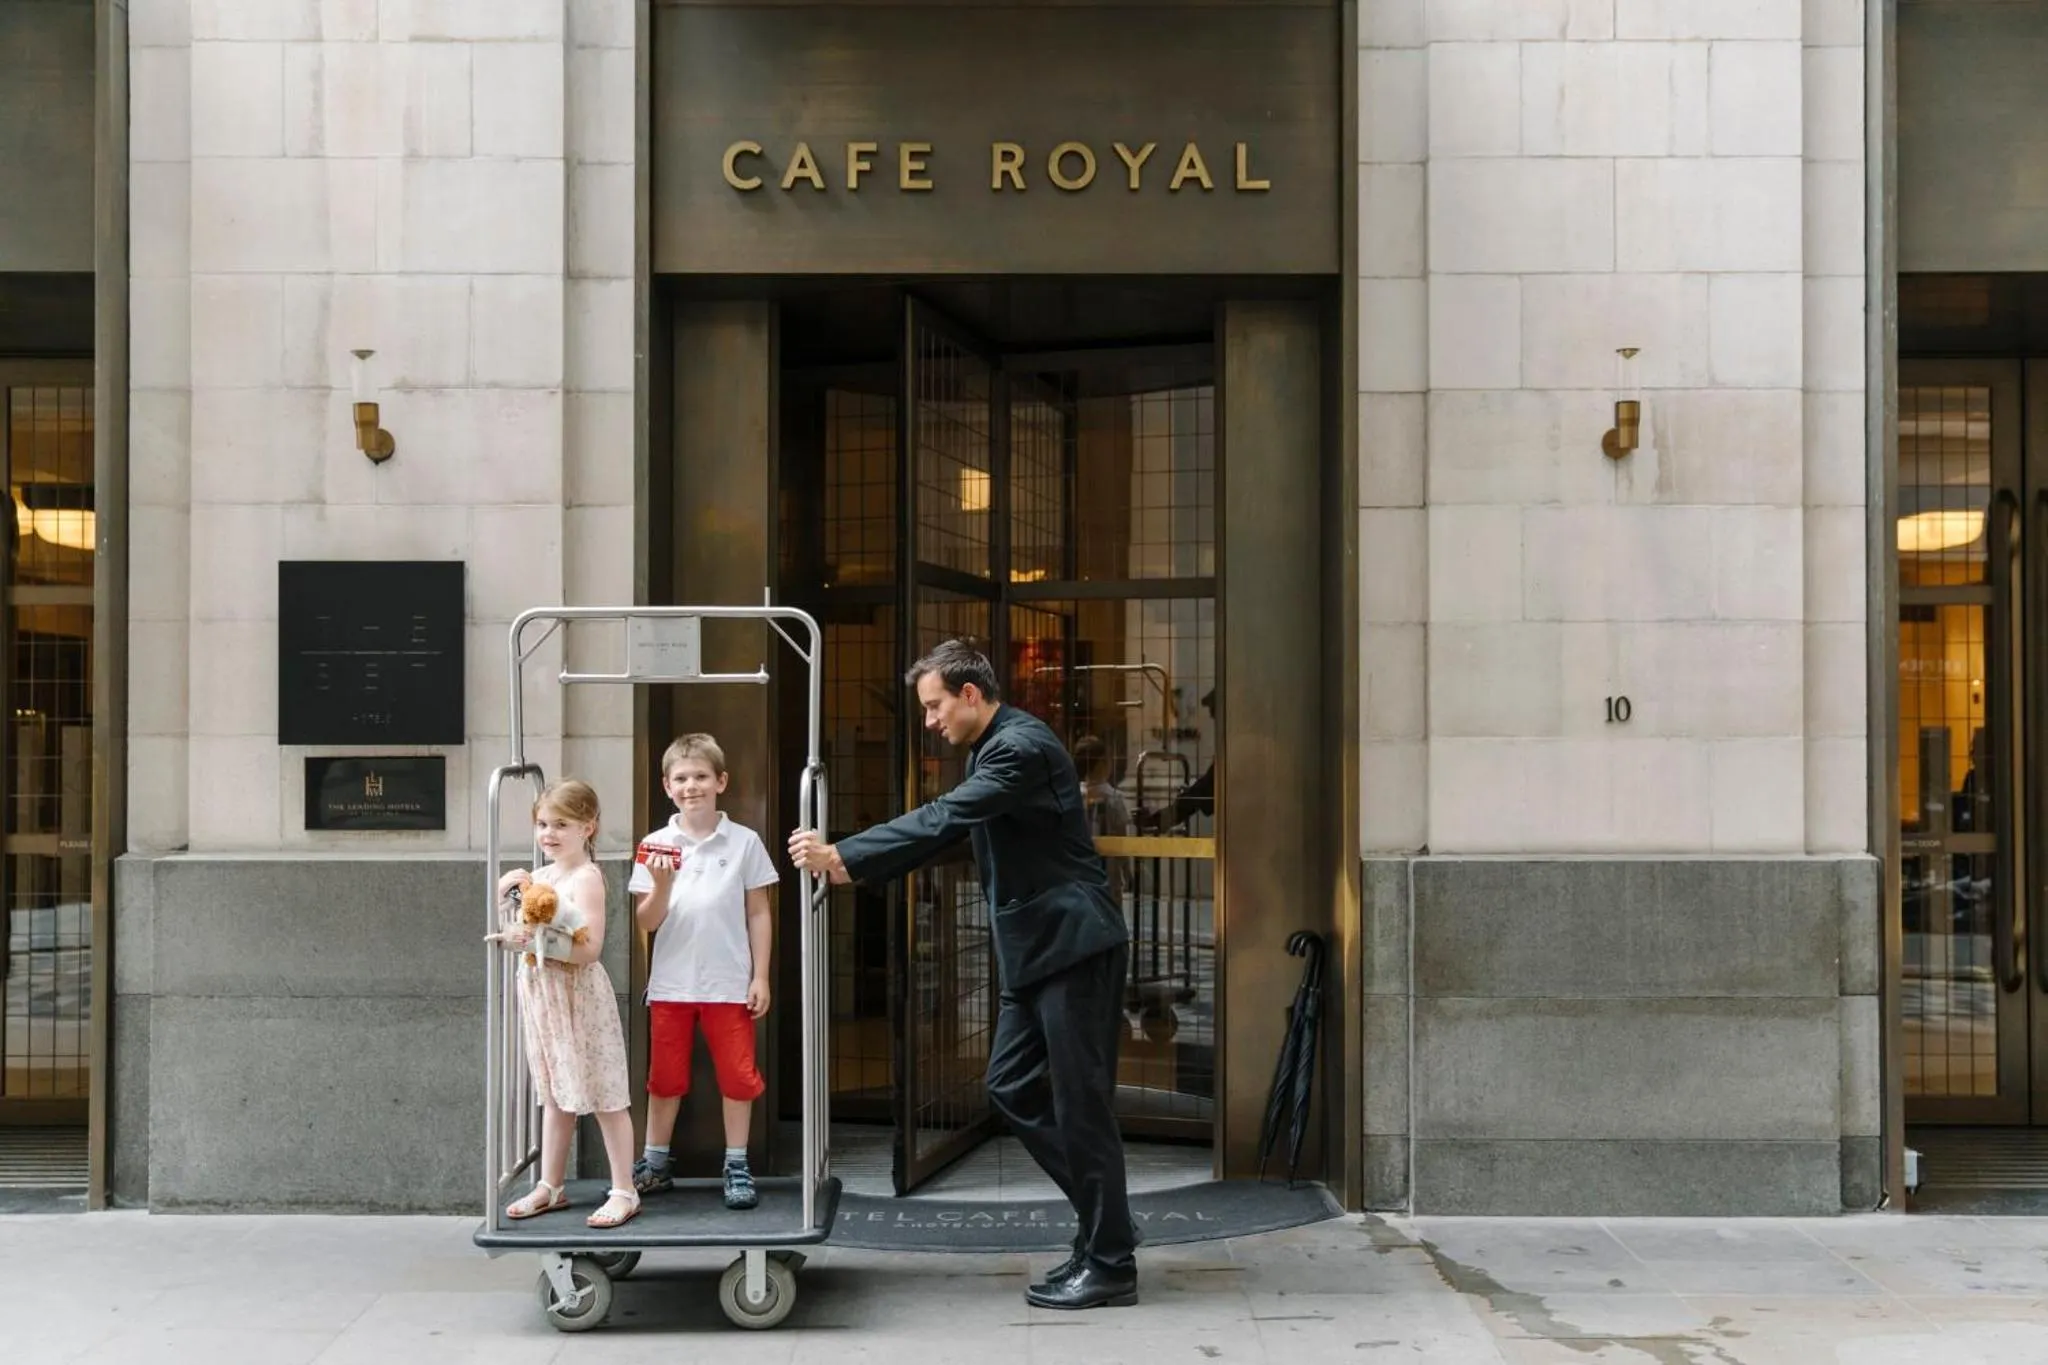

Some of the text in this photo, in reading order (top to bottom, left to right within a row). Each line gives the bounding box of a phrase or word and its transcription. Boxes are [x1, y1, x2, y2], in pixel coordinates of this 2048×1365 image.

[722, 140, 1272, 191] CAFE ROYAL
[1605, 695, 1632, 723] 10
[837, 1211, 915, 1222] TEL
